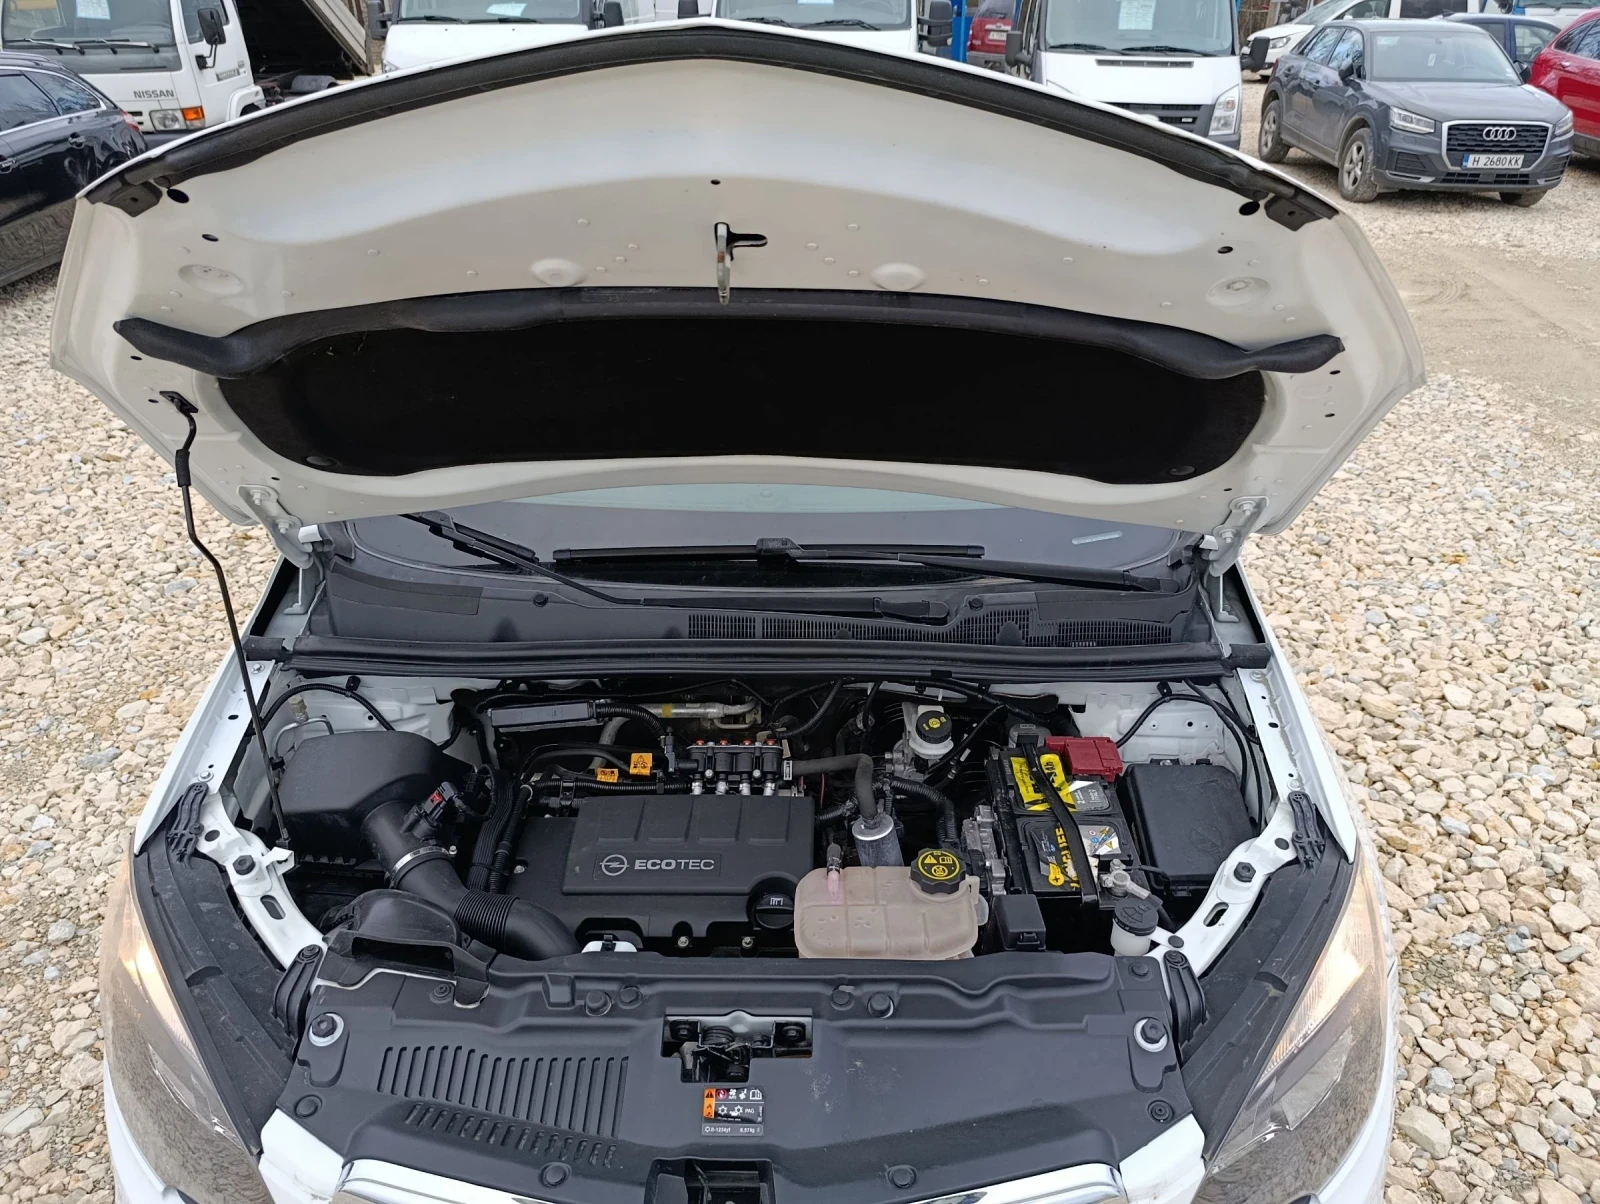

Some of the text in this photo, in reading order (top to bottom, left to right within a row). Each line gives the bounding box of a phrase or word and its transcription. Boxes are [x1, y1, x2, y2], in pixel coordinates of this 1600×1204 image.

[133, 90, 175, 98] NISSAN
[1472, 157, 1480, 166] H
[634, 859, 715, 870] ECOTEC
